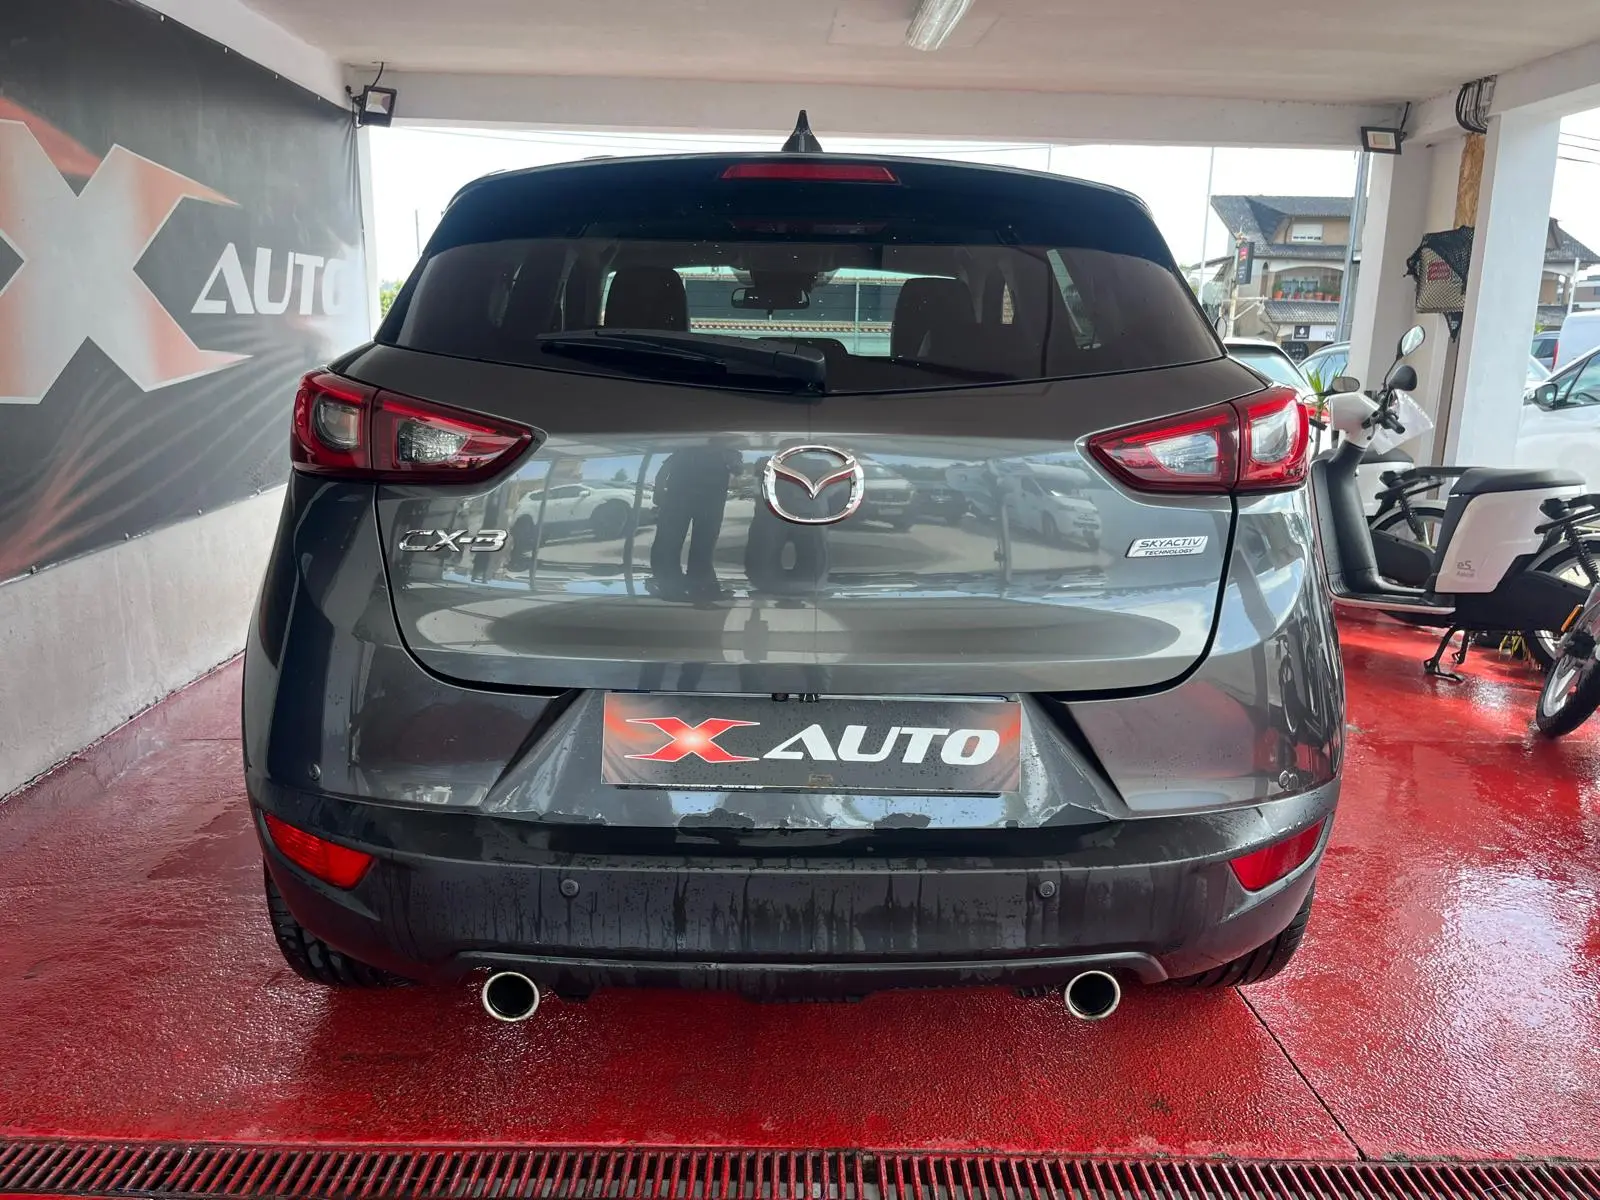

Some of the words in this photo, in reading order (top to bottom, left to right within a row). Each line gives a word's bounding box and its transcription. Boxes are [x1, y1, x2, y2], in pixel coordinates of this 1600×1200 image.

[398, 529, 508, 552] CX-3
[1139, 537, 1202, 548] SKYACTIV
[1144, 548, 1194, 556] TECHNOLOGY
[763, 723, 1000, 766] AUTO
